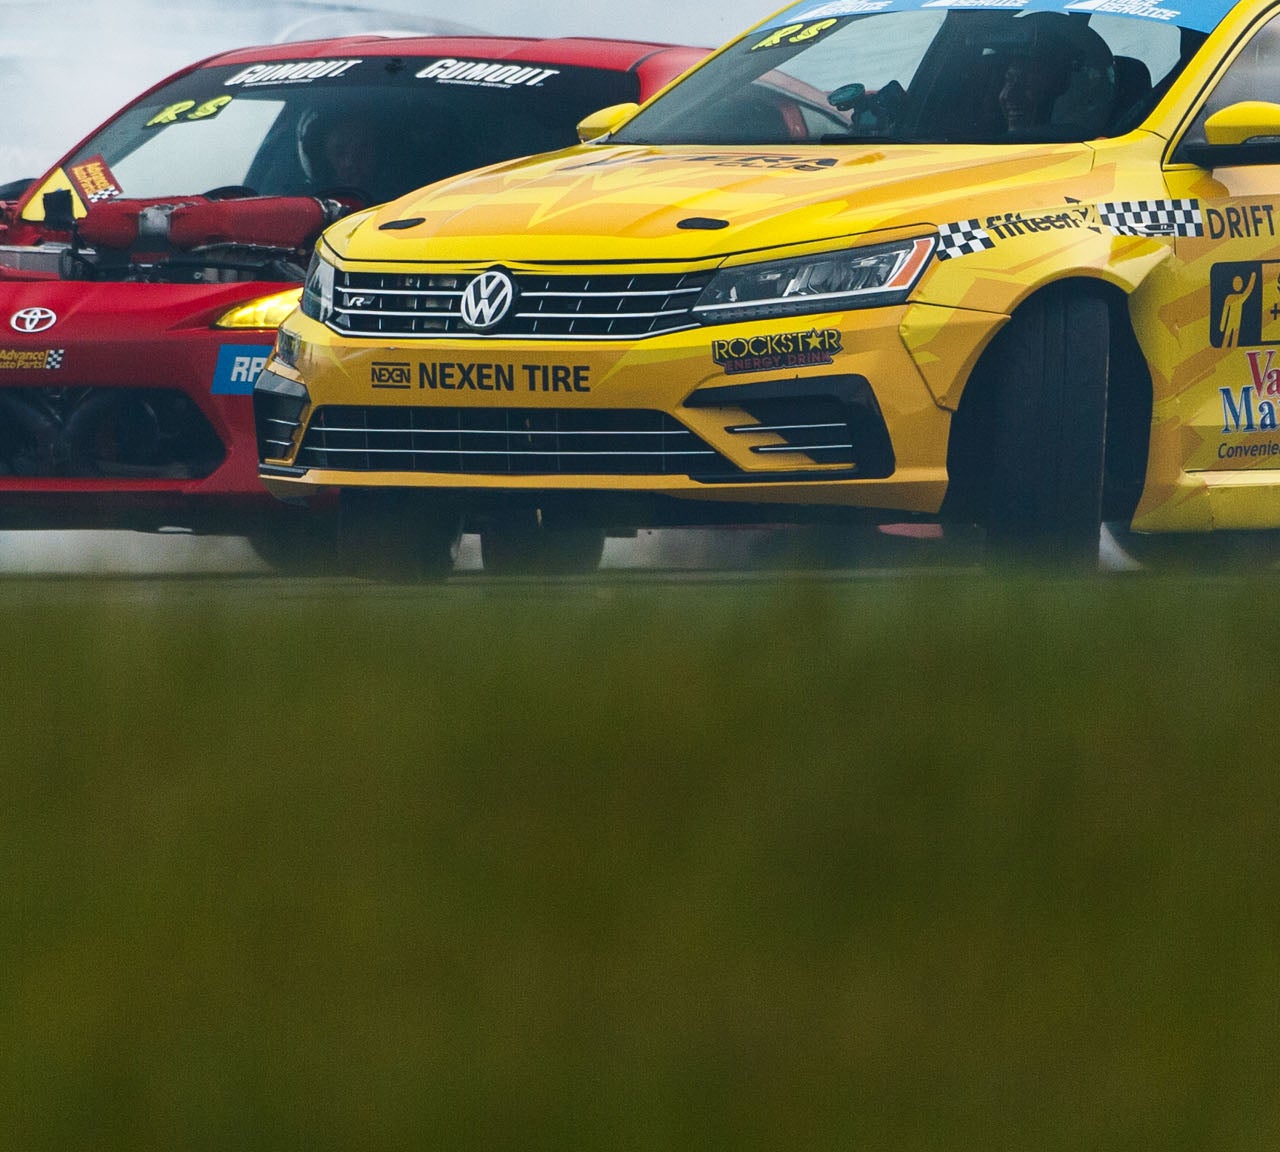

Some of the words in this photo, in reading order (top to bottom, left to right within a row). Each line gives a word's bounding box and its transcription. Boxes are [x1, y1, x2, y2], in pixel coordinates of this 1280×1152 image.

[224, 60, 363, 86] GUMOUT
[415, 58, 560, 86] GUMOUT
[1206, 204, 1275, 239] DRIFT
[17, 359, 42, 368] Parts
[725, 356, 781, 370] ENERGY
[787, 352, 831, 365] DRINK
[419, 362, 514, 391] NEXEN
[522, 365, 591, 392] TIRE
